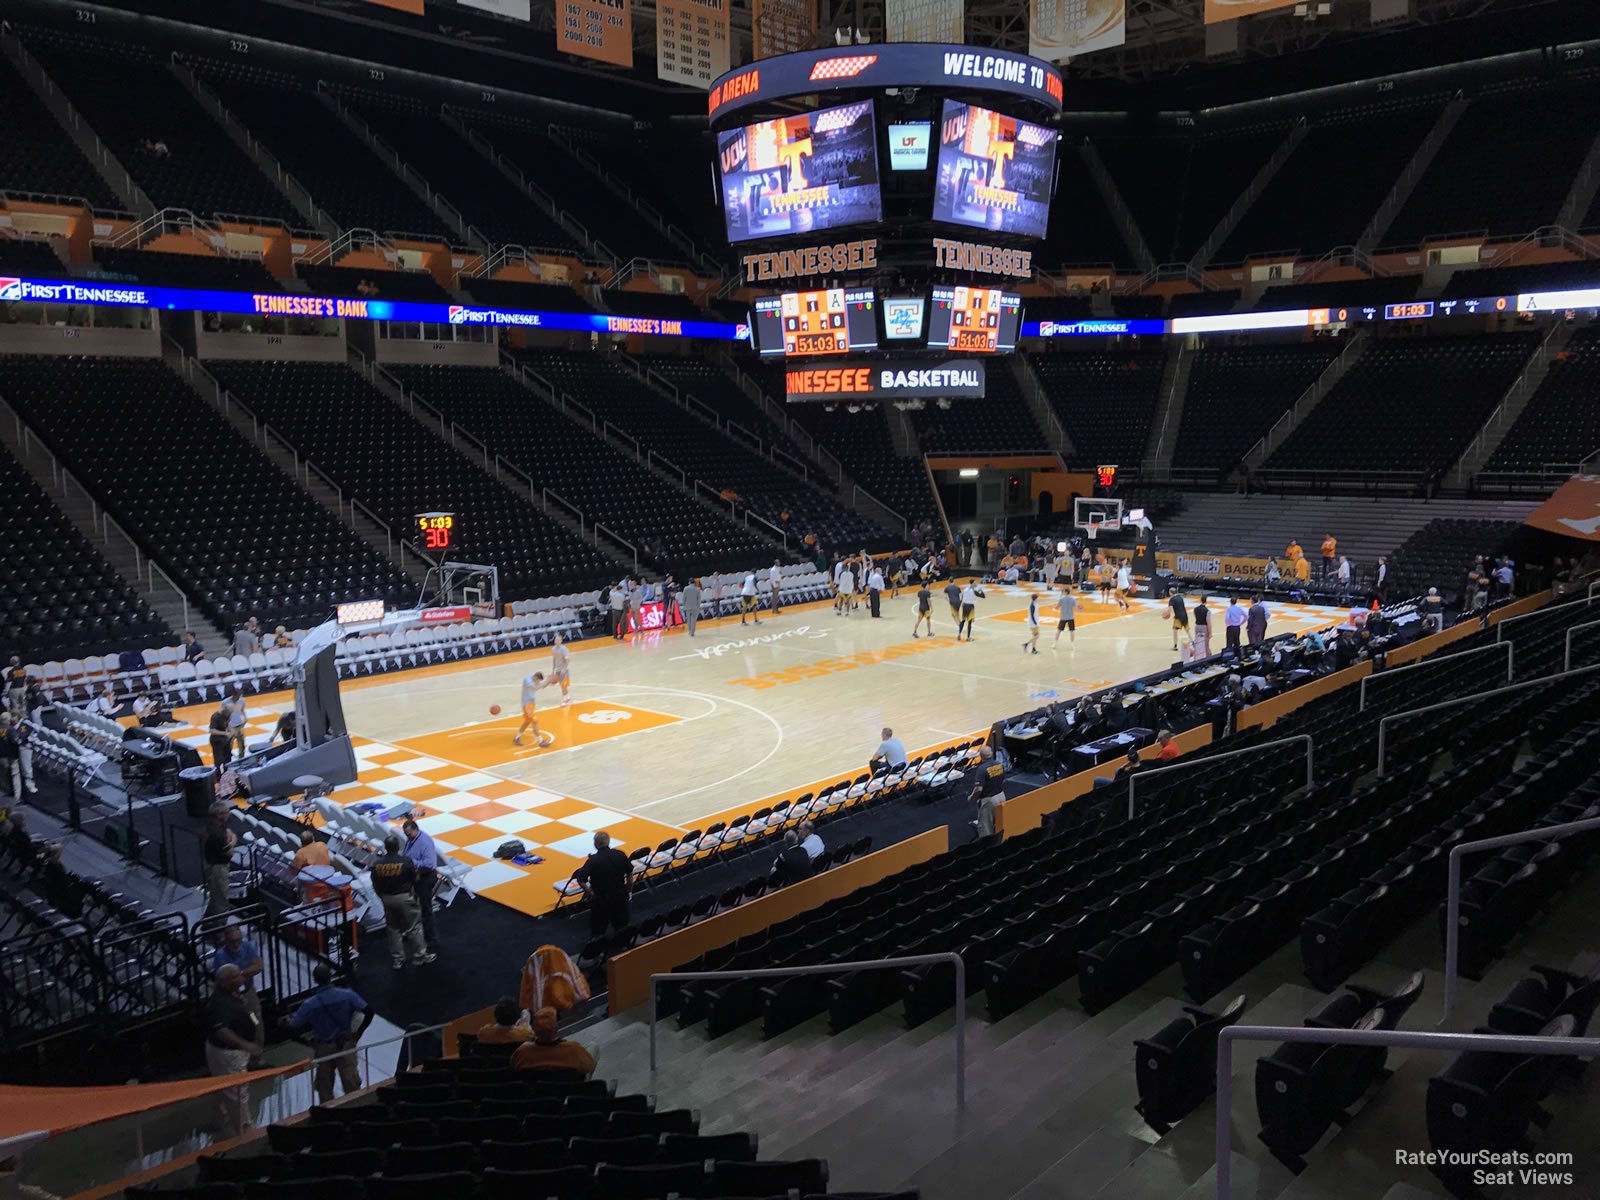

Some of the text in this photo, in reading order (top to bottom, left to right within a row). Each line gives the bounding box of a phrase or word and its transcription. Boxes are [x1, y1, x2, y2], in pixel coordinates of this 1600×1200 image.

[76, 9, 96, 24] 321
[564, 4, 581, 16] 1967
[585, 8, 603, 21] 2007
[607, 15, 624, 27] 2014
[565, 16, 580, 28] 1981
[565, 30, 603, 47] 2000 2010
[230, 40, 249, 53] 322
[1565, 48, 1584, 61] 329
[369, 69, 385, 81] 323
[943, 52, 1027, 85] WELCOME
[1030, 65, 1044, 89] TO
[721, 70, 760, 105] ARENA
[768, 185, 831, 208] TENNESSEE
[973, 184, 1019, 206] TENNESSEE
[743, 239, 878, 282] TENNESSEE
[933, 237, 1032, 278] TENNESSEE
[22, 282, 63, 299] FIRST
[253, 294, 368, 318] TENNESSEE'S BANK
[1392, 304, 1426, 317] 51:03
[1495, 297, 1507, 311] 0
[464, 309, 488, 323] FIRST
[833, 315, 841, 327] 0
[956, 313, 962, 325] 0
[989, 315, 995, 327] 0
[1311, 310, 1325, 324] T
[1338, 308, 1348, 321] 0
[607, 317, 682, 335] TENNESSEE'S BANK
[788, 319, 796, 330] 0
[802, 322, 808, 331] 4
[821, 320, 827, 330] 4
[1053, 323, 1077, 334] FIRST
[799, 337, 834, 352] 51:03
[960, 334, 987, 348] 51:03
[880, 370, 979, 388] BASKETBALL
[1100, 473, 1113, 485] 30
[419, 516, 452, 530] 51:03
[426, 528, 449, 548] 30
[1135, 545, 1147, 558] T
